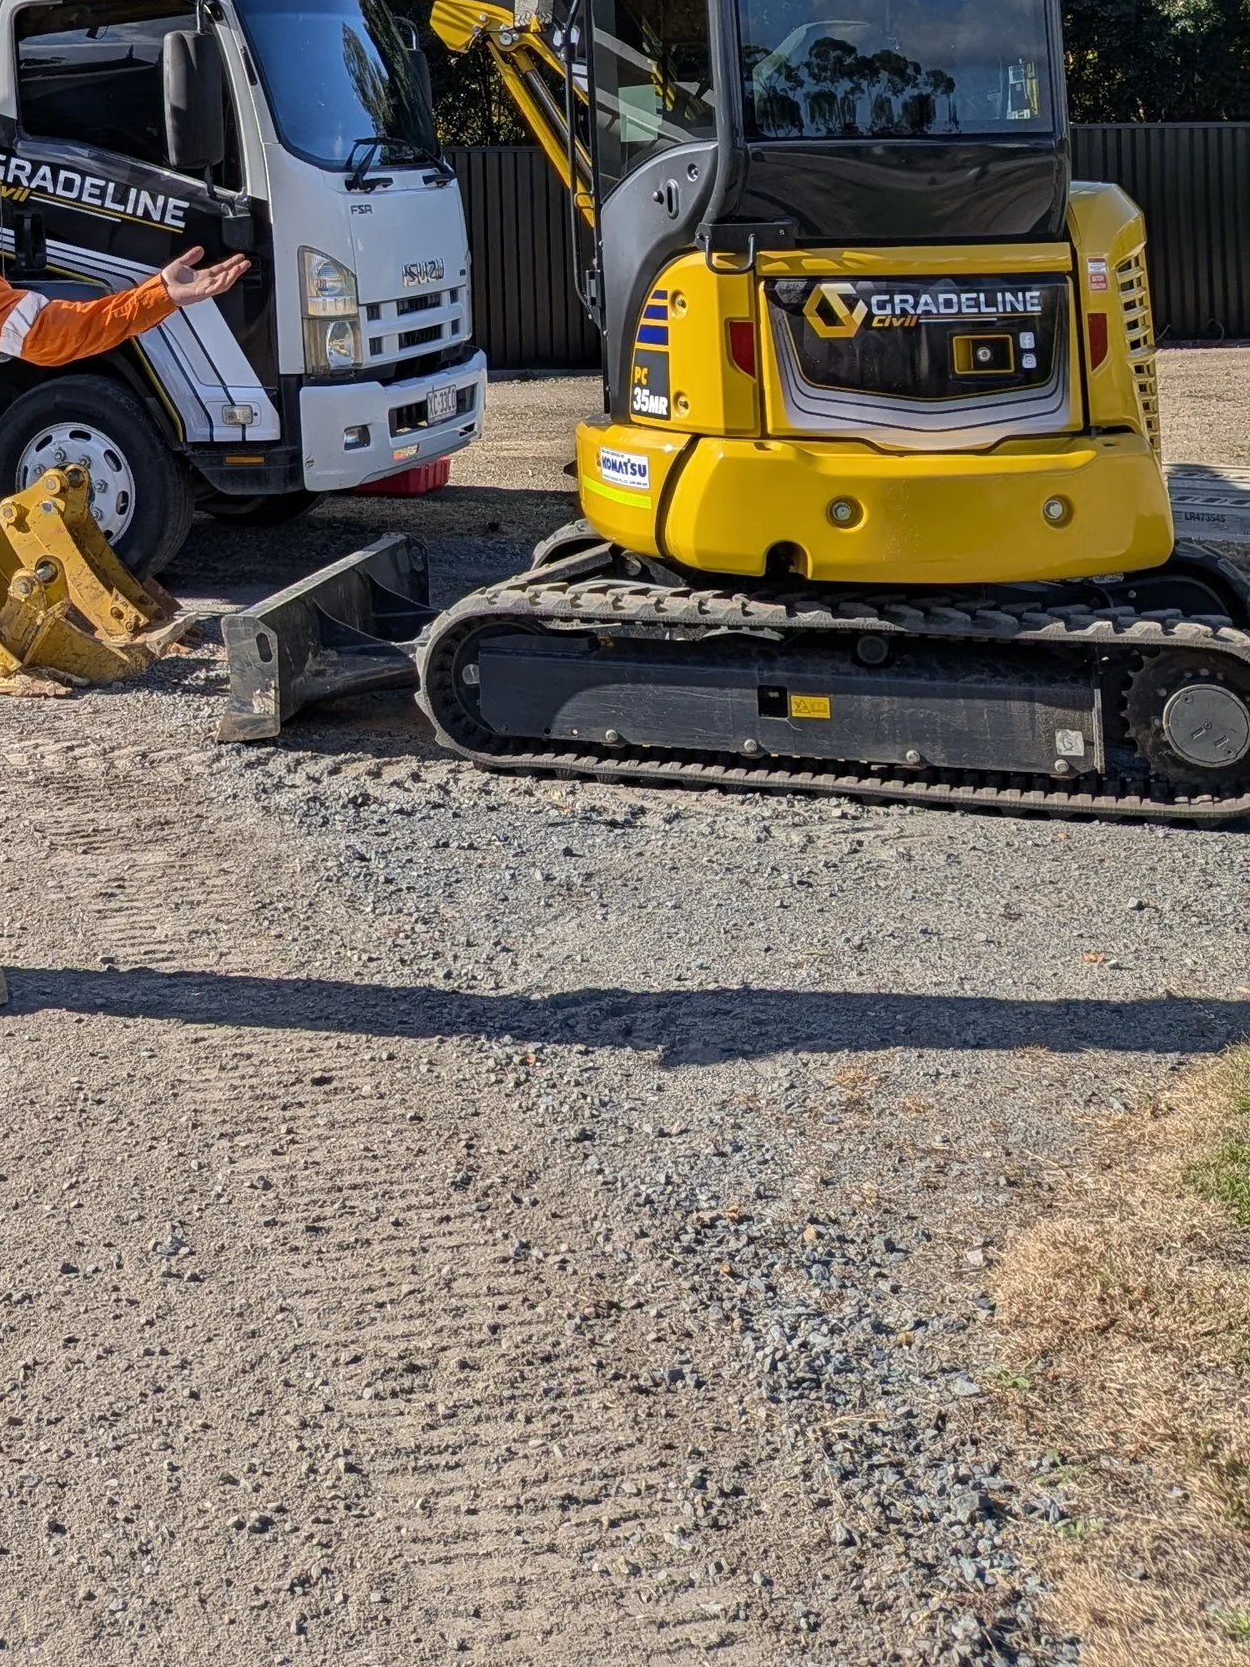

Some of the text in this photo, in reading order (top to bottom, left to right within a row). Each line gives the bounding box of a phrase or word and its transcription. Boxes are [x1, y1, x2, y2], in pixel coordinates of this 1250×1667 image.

[350, 204, 373, 215] FSR
[401, 257, 445, 287] ISUZU
[871, 291, 1042, 315] GRADELINE
[871, 315, 919, 327] Civil
[634, 365, 648, 386] PC
[633, 387, 669, 416] 35MR
[601, 455, 647, 478] KOMATSU
